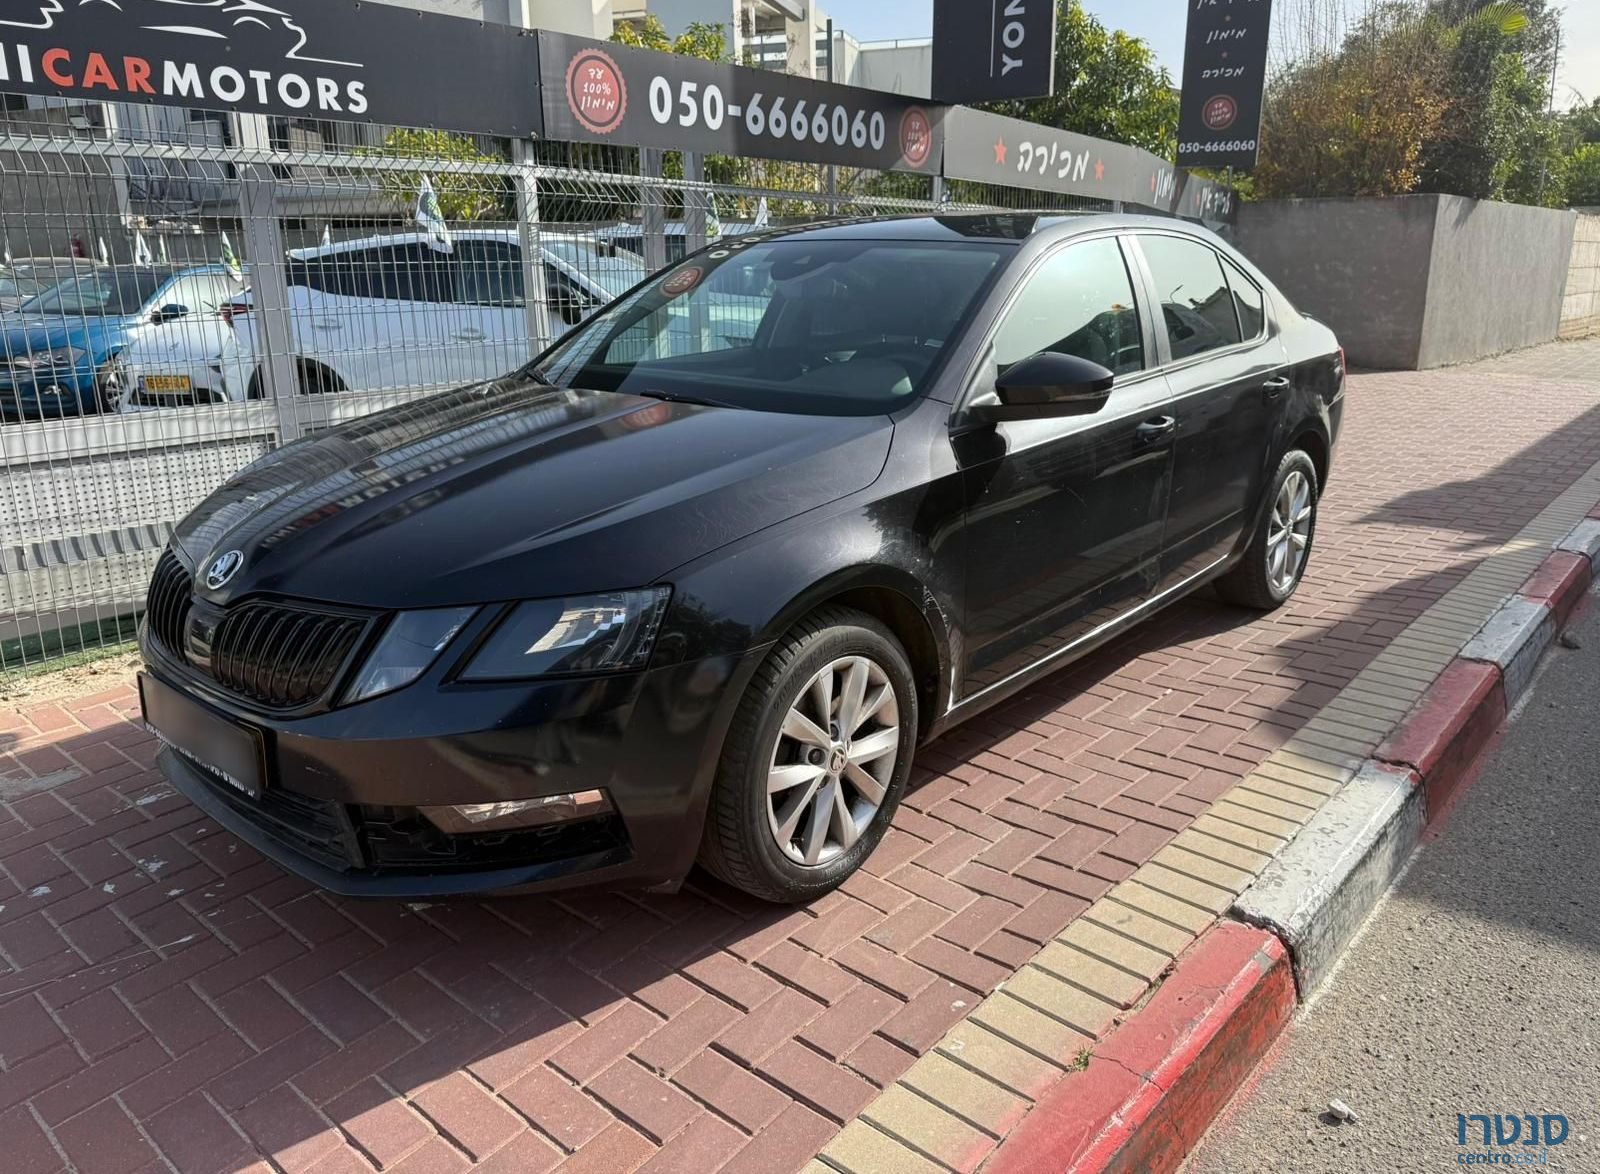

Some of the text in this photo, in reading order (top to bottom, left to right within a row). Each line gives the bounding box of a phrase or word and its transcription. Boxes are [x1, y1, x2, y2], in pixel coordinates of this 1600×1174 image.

[1206, 28, 1247, 44] מימון
[583, 82, 612, 95] 100%
[580, 96, 615, 111] מימון
[649, 75, 885, 150] 050-6666060
[1178, 139, 1256, 154] 050-6666060
[1017, 141, 1090, 181] מכירה
